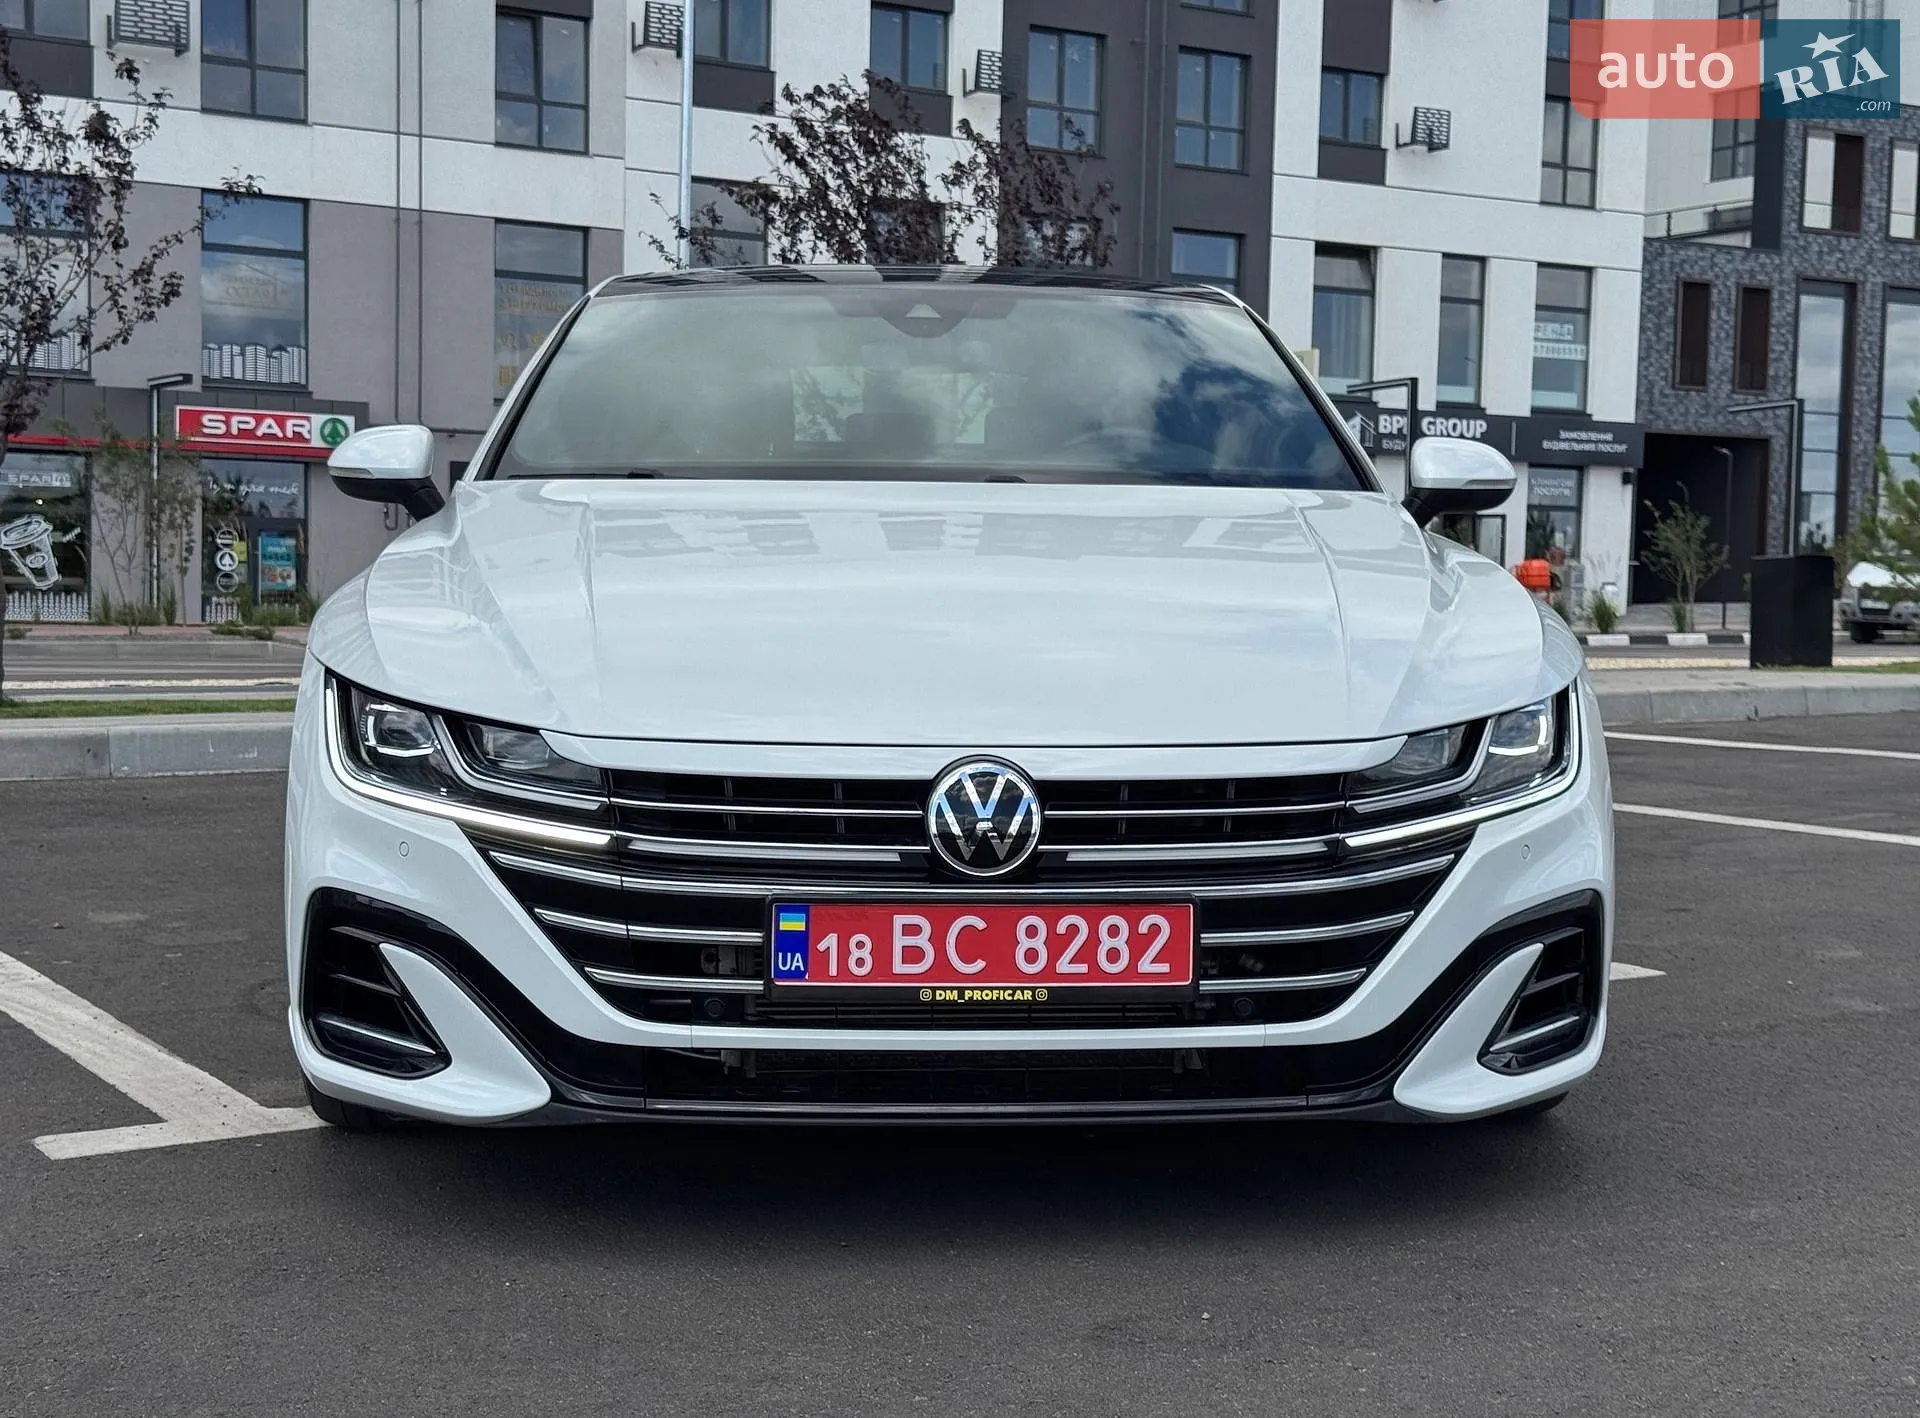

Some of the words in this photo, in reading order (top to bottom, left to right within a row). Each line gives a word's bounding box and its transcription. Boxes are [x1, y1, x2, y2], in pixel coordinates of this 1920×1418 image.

[201, 413, 311, 440] SPAR
[1421, 416, 1488, 438] GROUP
[817, 933, 873, 977] 18
[893, 915, 987, 975] BC
[1015, 915, 1171, 975] 8282
[778, 952, 805, 971] UA
[936, 989, 1033, 1003] DM_PROFICAR
